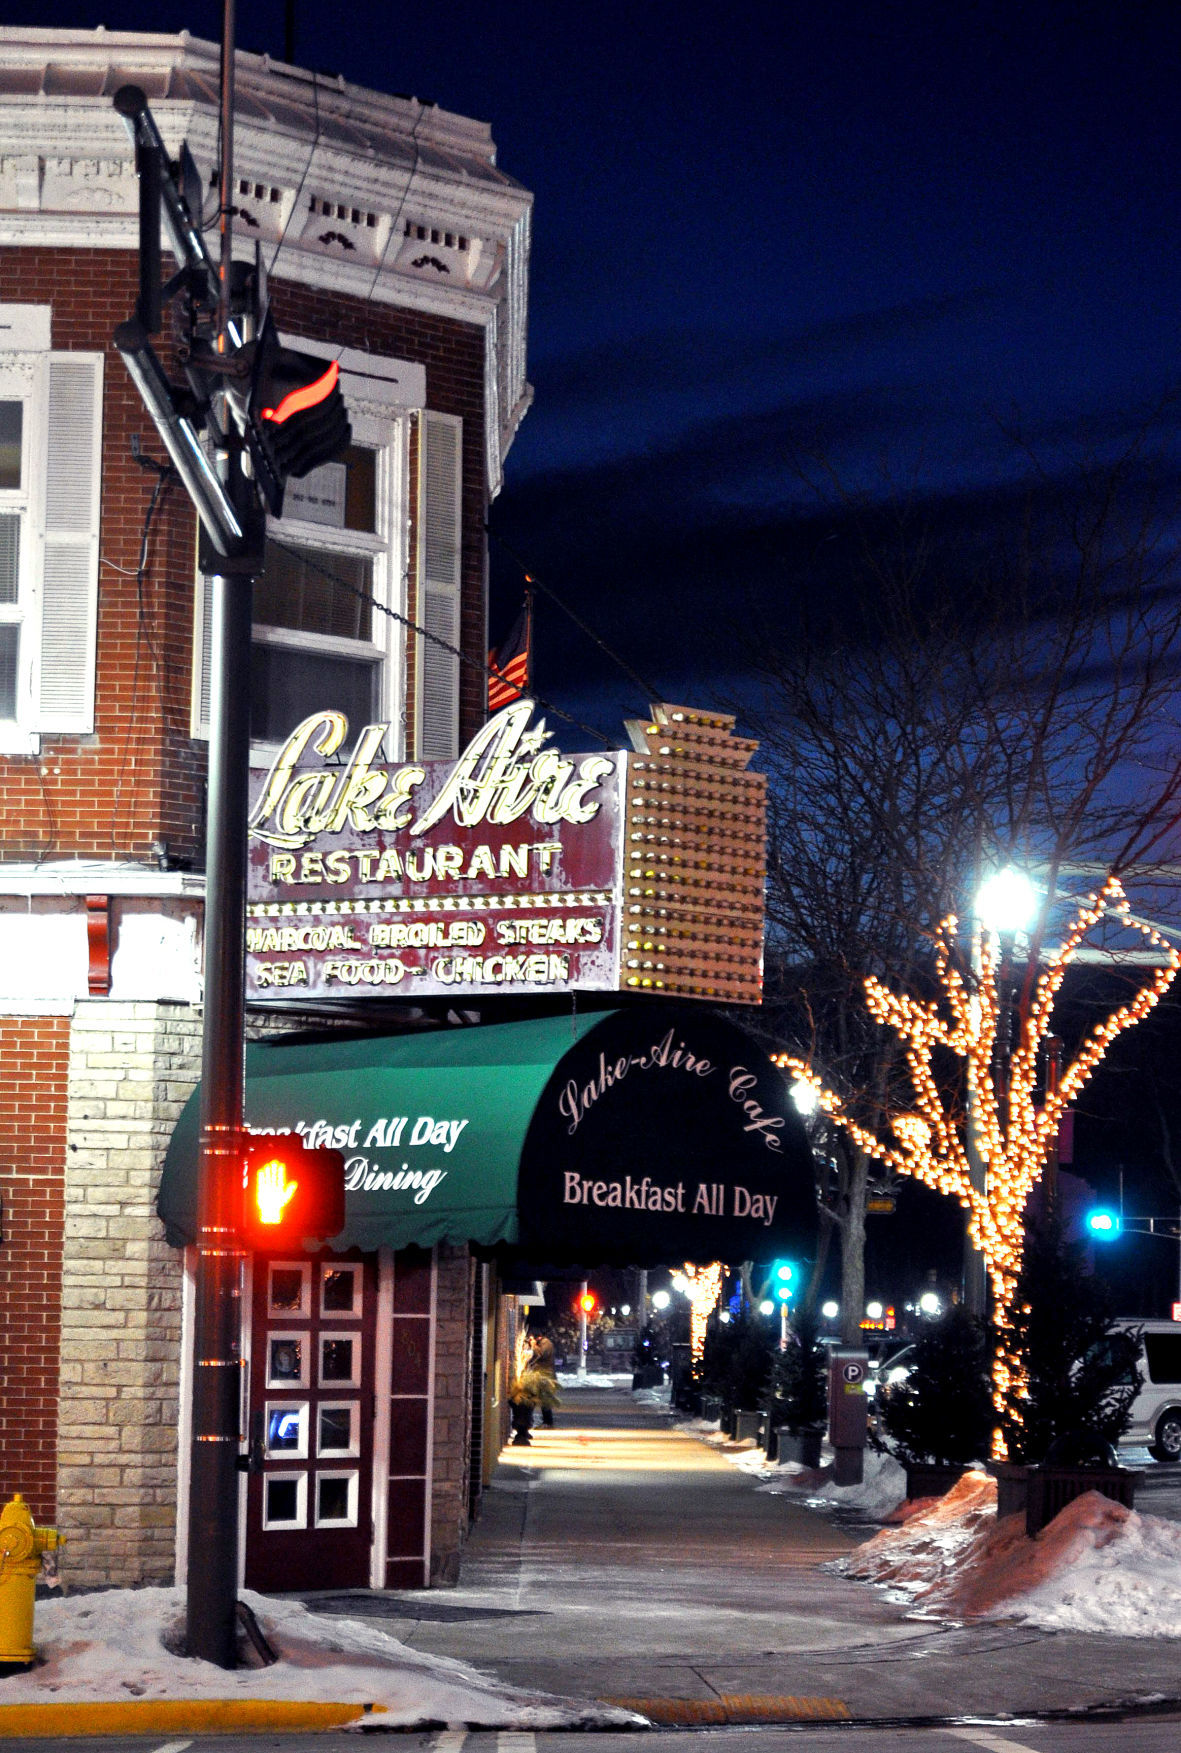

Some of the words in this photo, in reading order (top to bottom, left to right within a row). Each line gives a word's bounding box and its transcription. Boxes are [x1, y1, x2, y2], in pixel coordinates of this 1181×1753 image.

[248, 710, 425, 849] Lake
[410, 699, 615, 836] Aire
[270, 842, 563, 885] RESTAURANT
[246, 925, 361, 952] HARCOAL
[370, 922, 486, 948] BROILED
[497, 917, 603, 945] STEAKS
[255, 961, 308, 987] SEA
[432, 954, 570, 983] CHICKEN
[729, 1065, 785, 1154] Cafe
[363, 1117, 409, 1148] All
[409, 1116, 469, 1152] Day
[344, 1156, 448, 1204] Dining
[563, 1171, 686, 1213] Breakfast
[691, 1183, 725, 1216] All
[732, 1186, 778, 1226] Day
[848, 1366, 859, 1380] P
